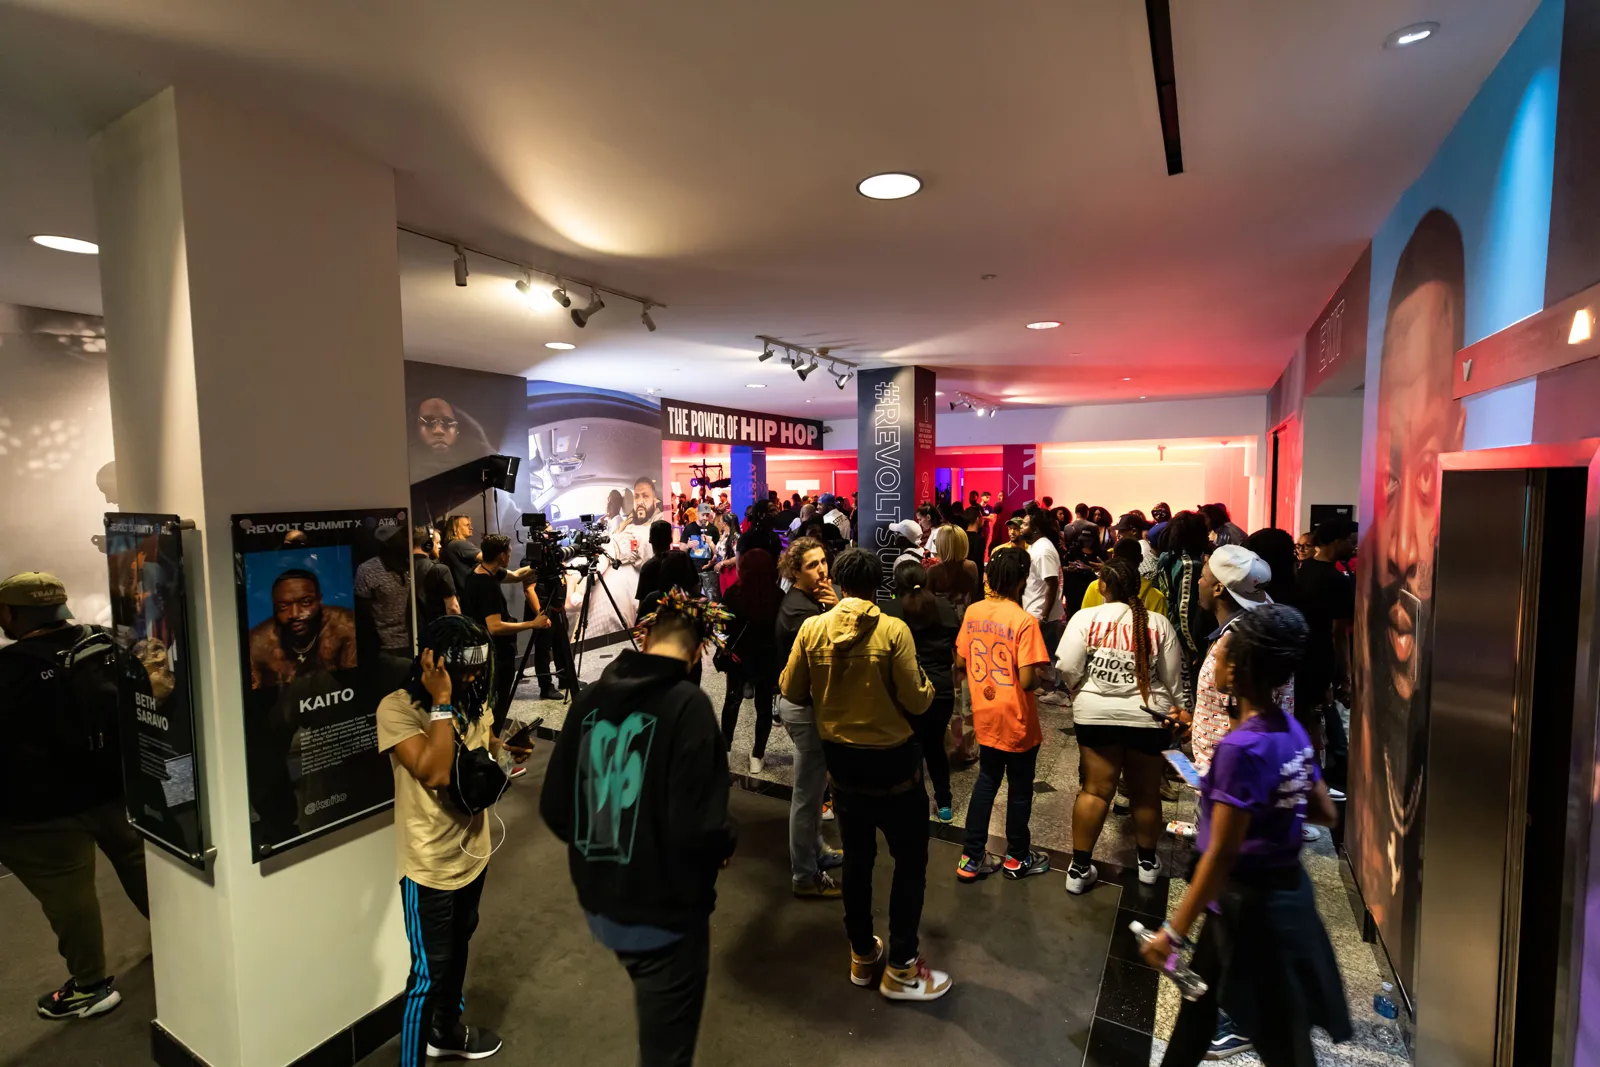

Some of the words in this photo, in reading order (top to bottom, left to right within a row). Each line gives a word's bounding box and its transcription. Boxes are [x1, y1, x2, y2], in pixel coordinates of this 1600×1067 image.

[667, 407, 689, 436] THE
[691, 409, 725, 439] POWER
[727, 415, 738, 440] OF
[740, 416, 778, 442] HIP
[780, 421, 818, 446] HOP
[875, 382, 901, 604] #REVOLTSUM
[246, 522, 301, 535] REVOLT
[303, 520, 353, 531] SUMMIT
[969, 637, 1015, 687] 69
[1087, 664, 1119, 684] APRIL
[1121, 671, 1135, 684] 13
[135, 692, 156, 711] BETH
[299, 687, 355, 713] KAITO
[136, 708, 169, 731] SARAVO
